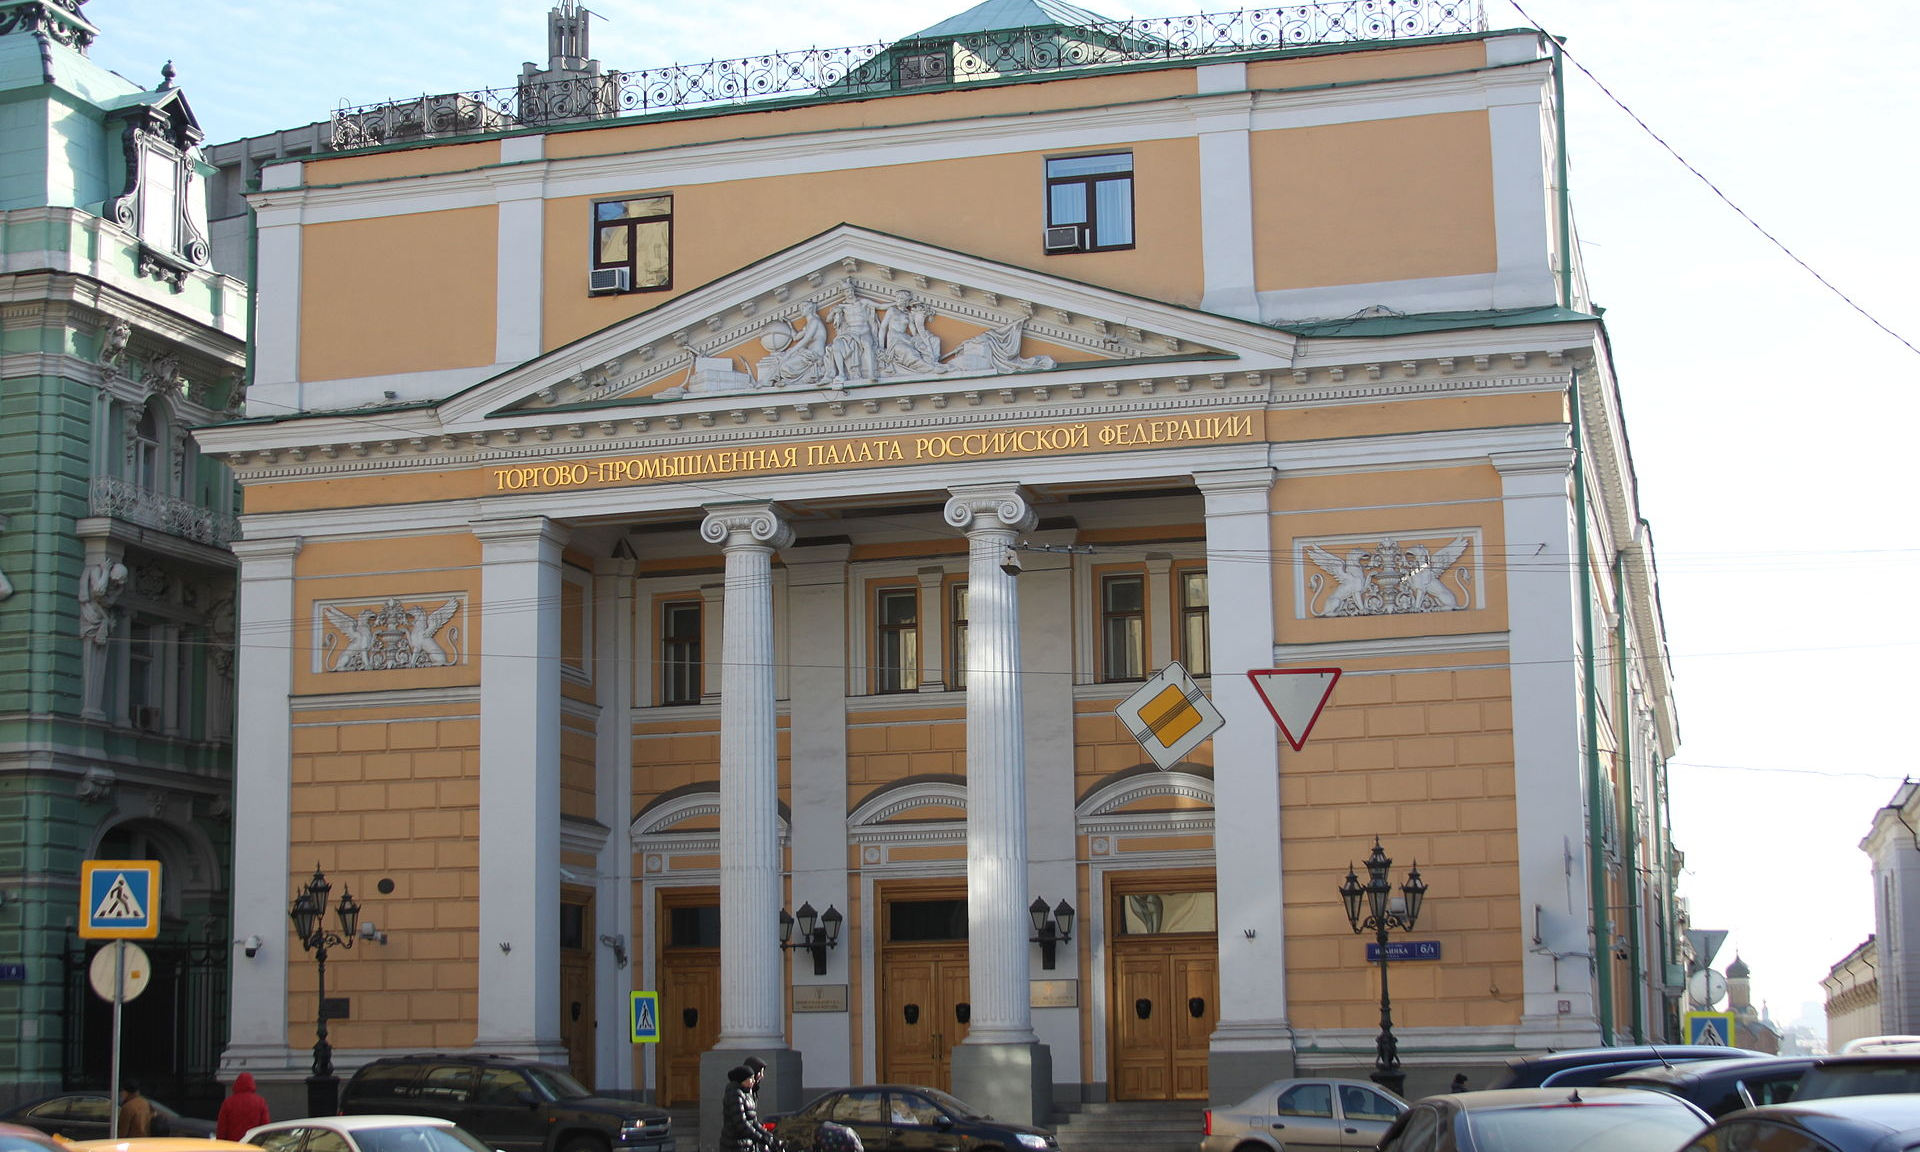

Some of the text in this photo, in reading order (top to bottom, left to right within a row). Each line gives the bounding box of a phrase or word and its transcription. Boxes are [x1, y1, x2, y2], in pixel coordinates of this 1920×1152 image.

[494, 415, 1253, 490] ТОРГОВО-ПРОМЫШЛЕННАЯ ПАЛАТА РОССИЙСКОЙ ФЕДЕРАЦИИ
